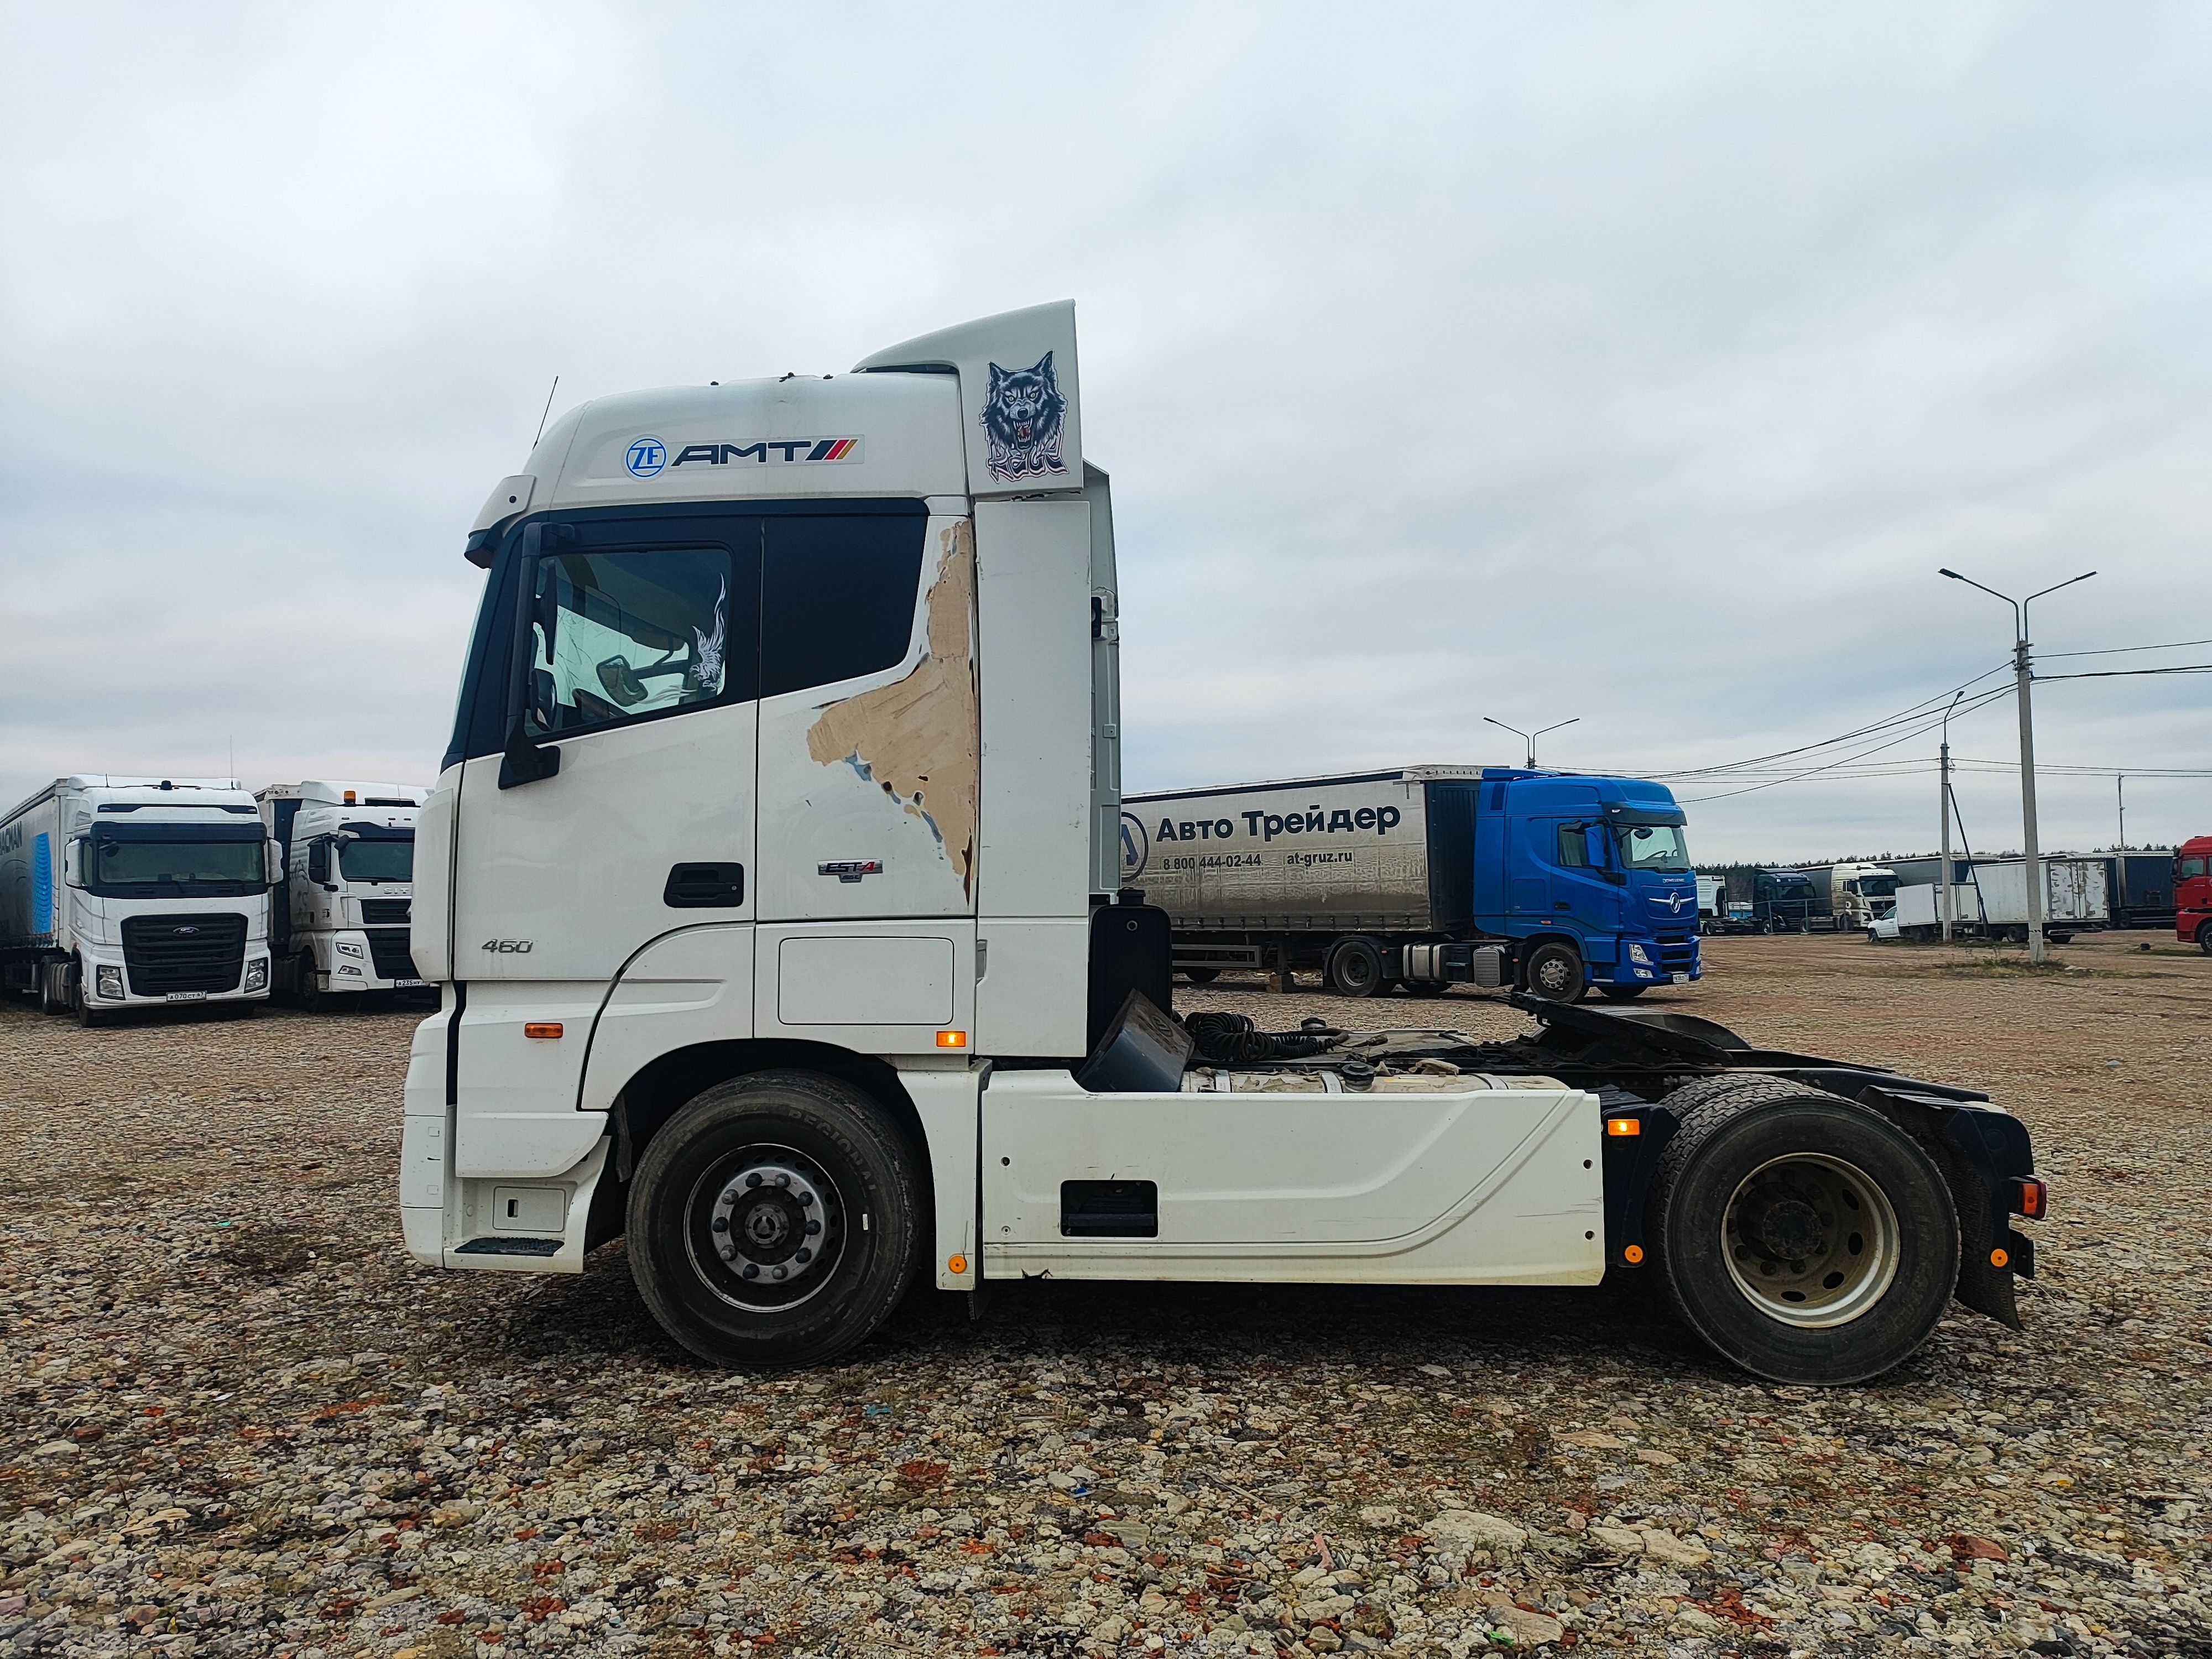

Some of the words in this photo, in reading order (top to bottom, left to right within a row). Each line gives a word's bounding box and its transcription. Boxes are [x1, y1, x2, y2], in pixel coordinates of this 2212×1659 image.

[629, 445, 664, 471] ZF
[671, 440, 811, 466] AMT
[1241, 805, 1401, 842] Трейдер
[1163, 858, 1171, 870] 8
[1174, 857, 1196, 869] 800
[1199, 854, 1261, 868] 444-02-44
[1287, 852, 1352, 867] at-gruz.ru
[482, 939, 533, 953] 460
